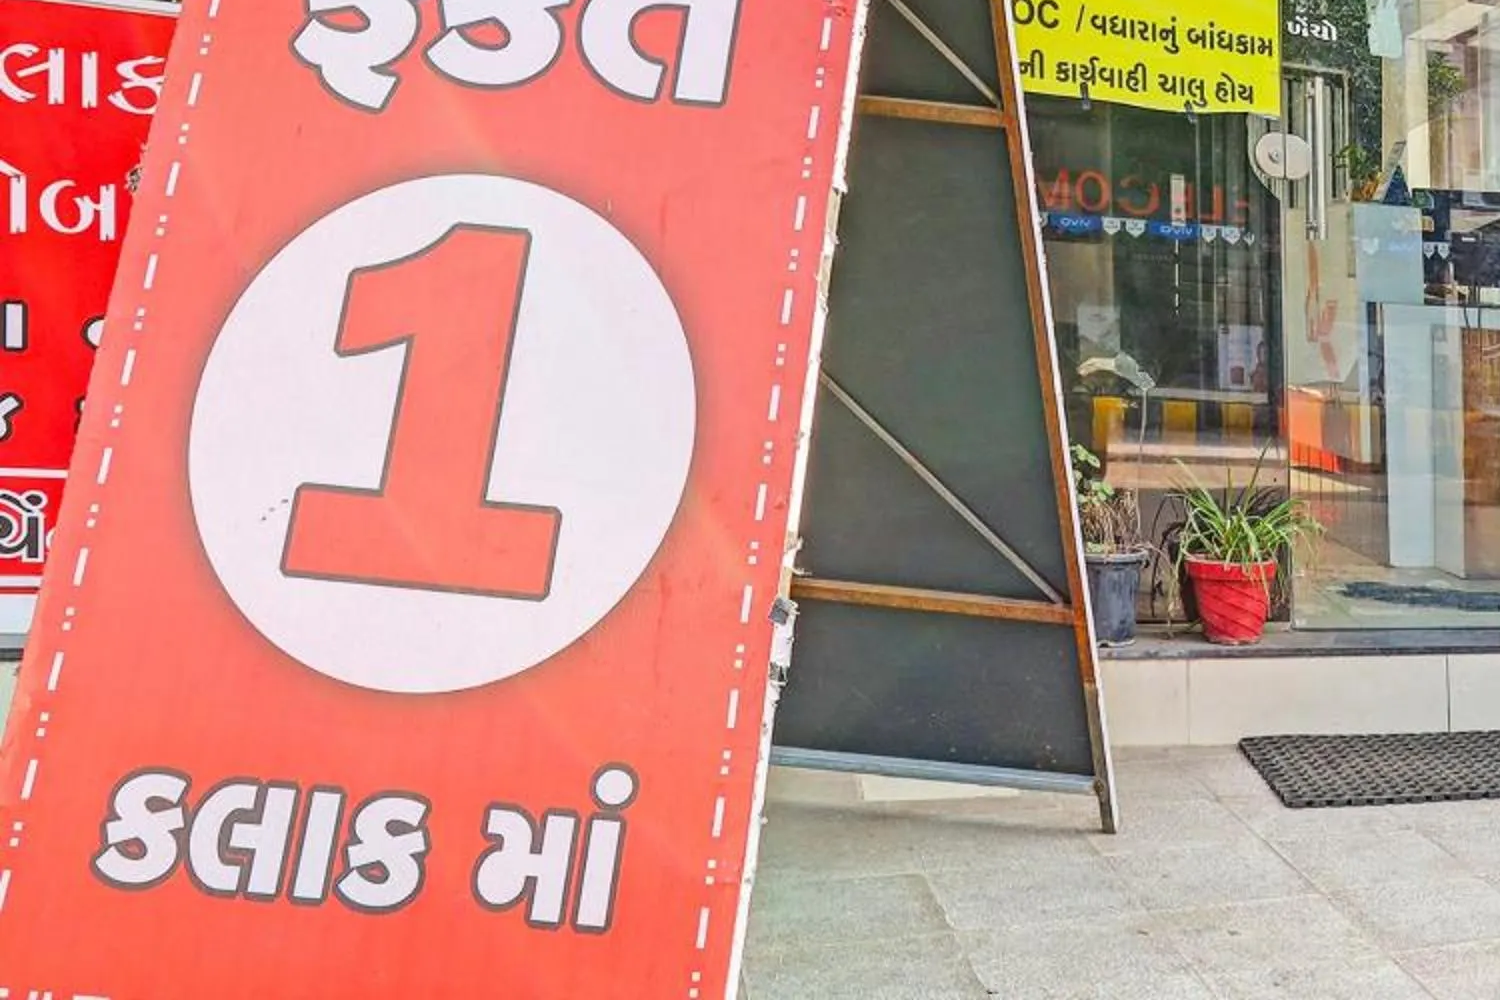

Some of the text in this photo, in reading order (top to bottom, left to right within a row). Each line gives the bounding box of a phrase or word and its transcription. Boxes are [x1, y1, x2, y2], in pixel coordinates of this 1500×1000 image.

[1158, 73, 1208, 107] ચાલુ
[1215, 72, 1253, 104] હોય
[1187, 21, 1273, 57] બાંધકામ
[280, 222, 562, 601] 1
[91, 762, 639, 934] કલાક માં
